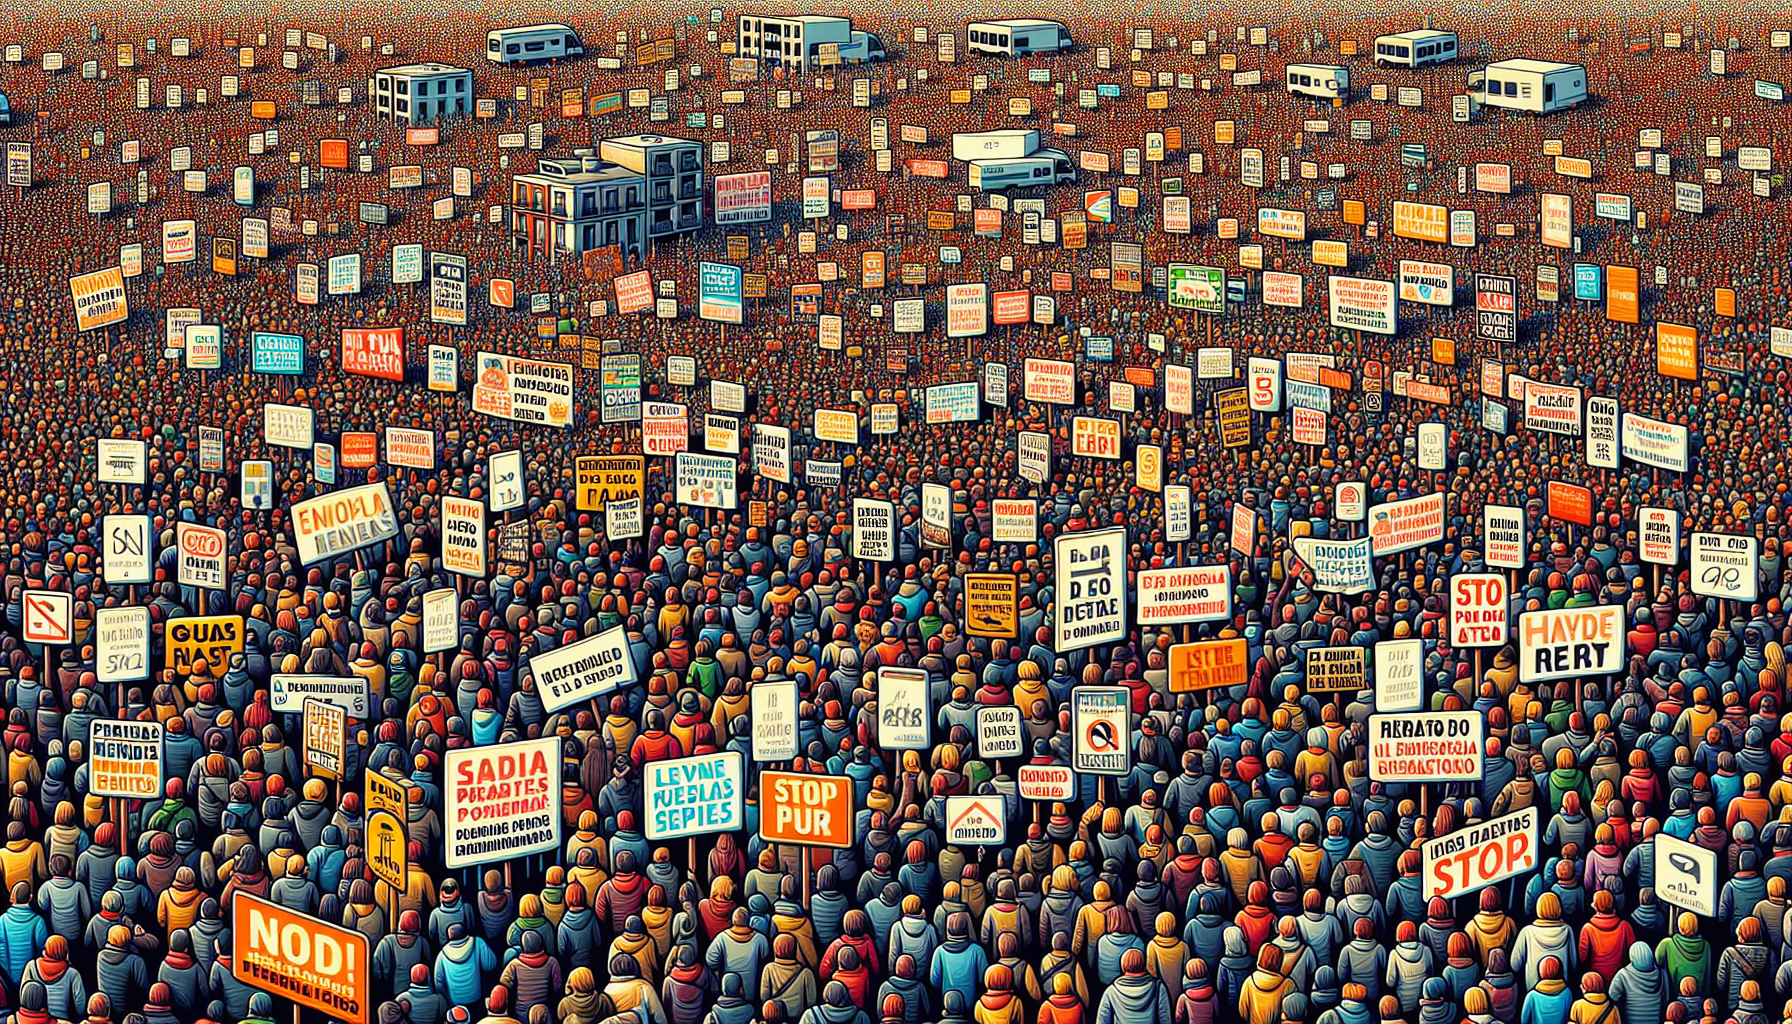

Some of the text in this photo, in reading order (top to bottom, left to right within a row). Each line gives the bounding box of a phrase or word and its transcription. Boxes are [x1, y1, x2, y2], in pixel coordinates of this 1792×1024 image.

[1456, 578, 1501, 607] STO
[1535, 642, 1610, 674] RERT
[456, 750, 548, 786] SADIA
[774, 778, 838, 808] STOP
[776, 804, 832, 837] PUR
[249, 908, 355, 984] NOD!
